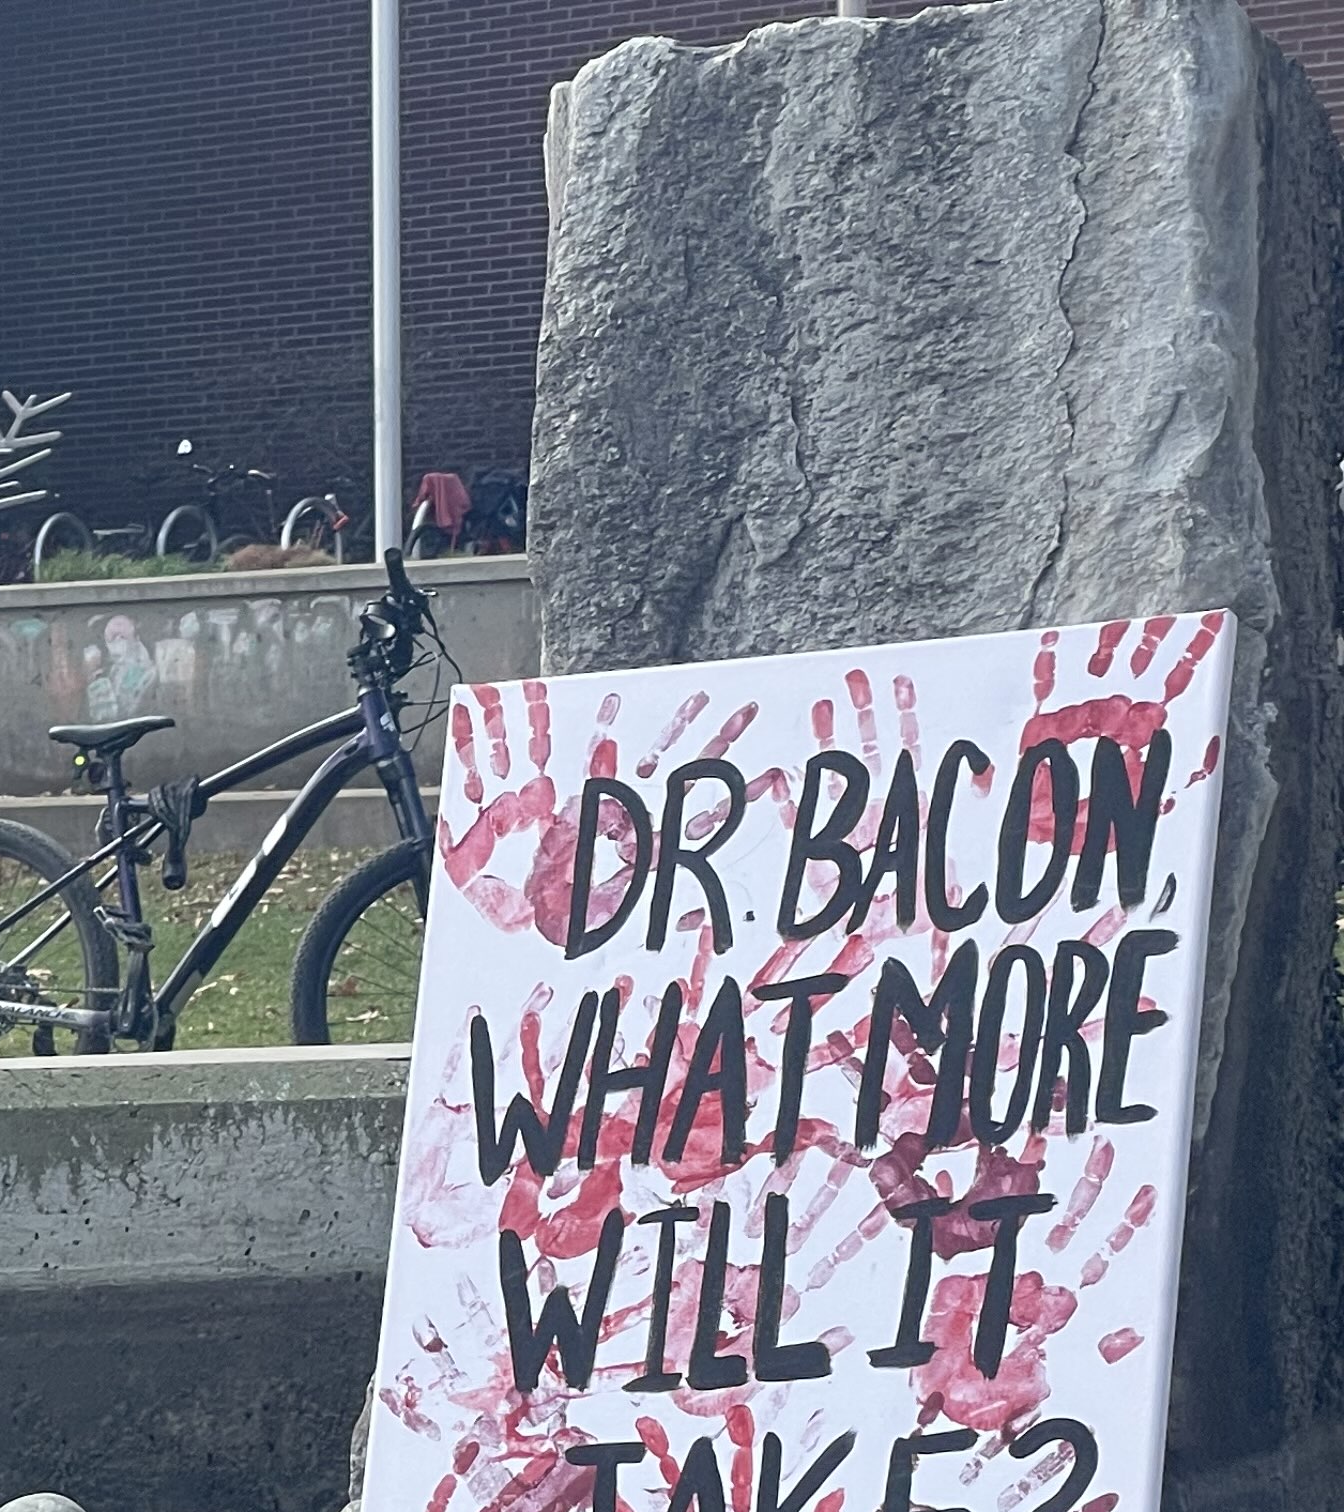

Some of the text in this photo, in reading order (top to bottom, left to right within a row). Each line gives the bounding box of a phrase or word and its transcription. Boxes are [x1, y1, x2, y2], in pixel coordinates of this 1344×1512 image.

[563, 728, 1176, 961] DR. BACON,
[469, 929, 1181, 1187] WHAT MORE
[498, 1192, 1058, 1393] WILL IT
